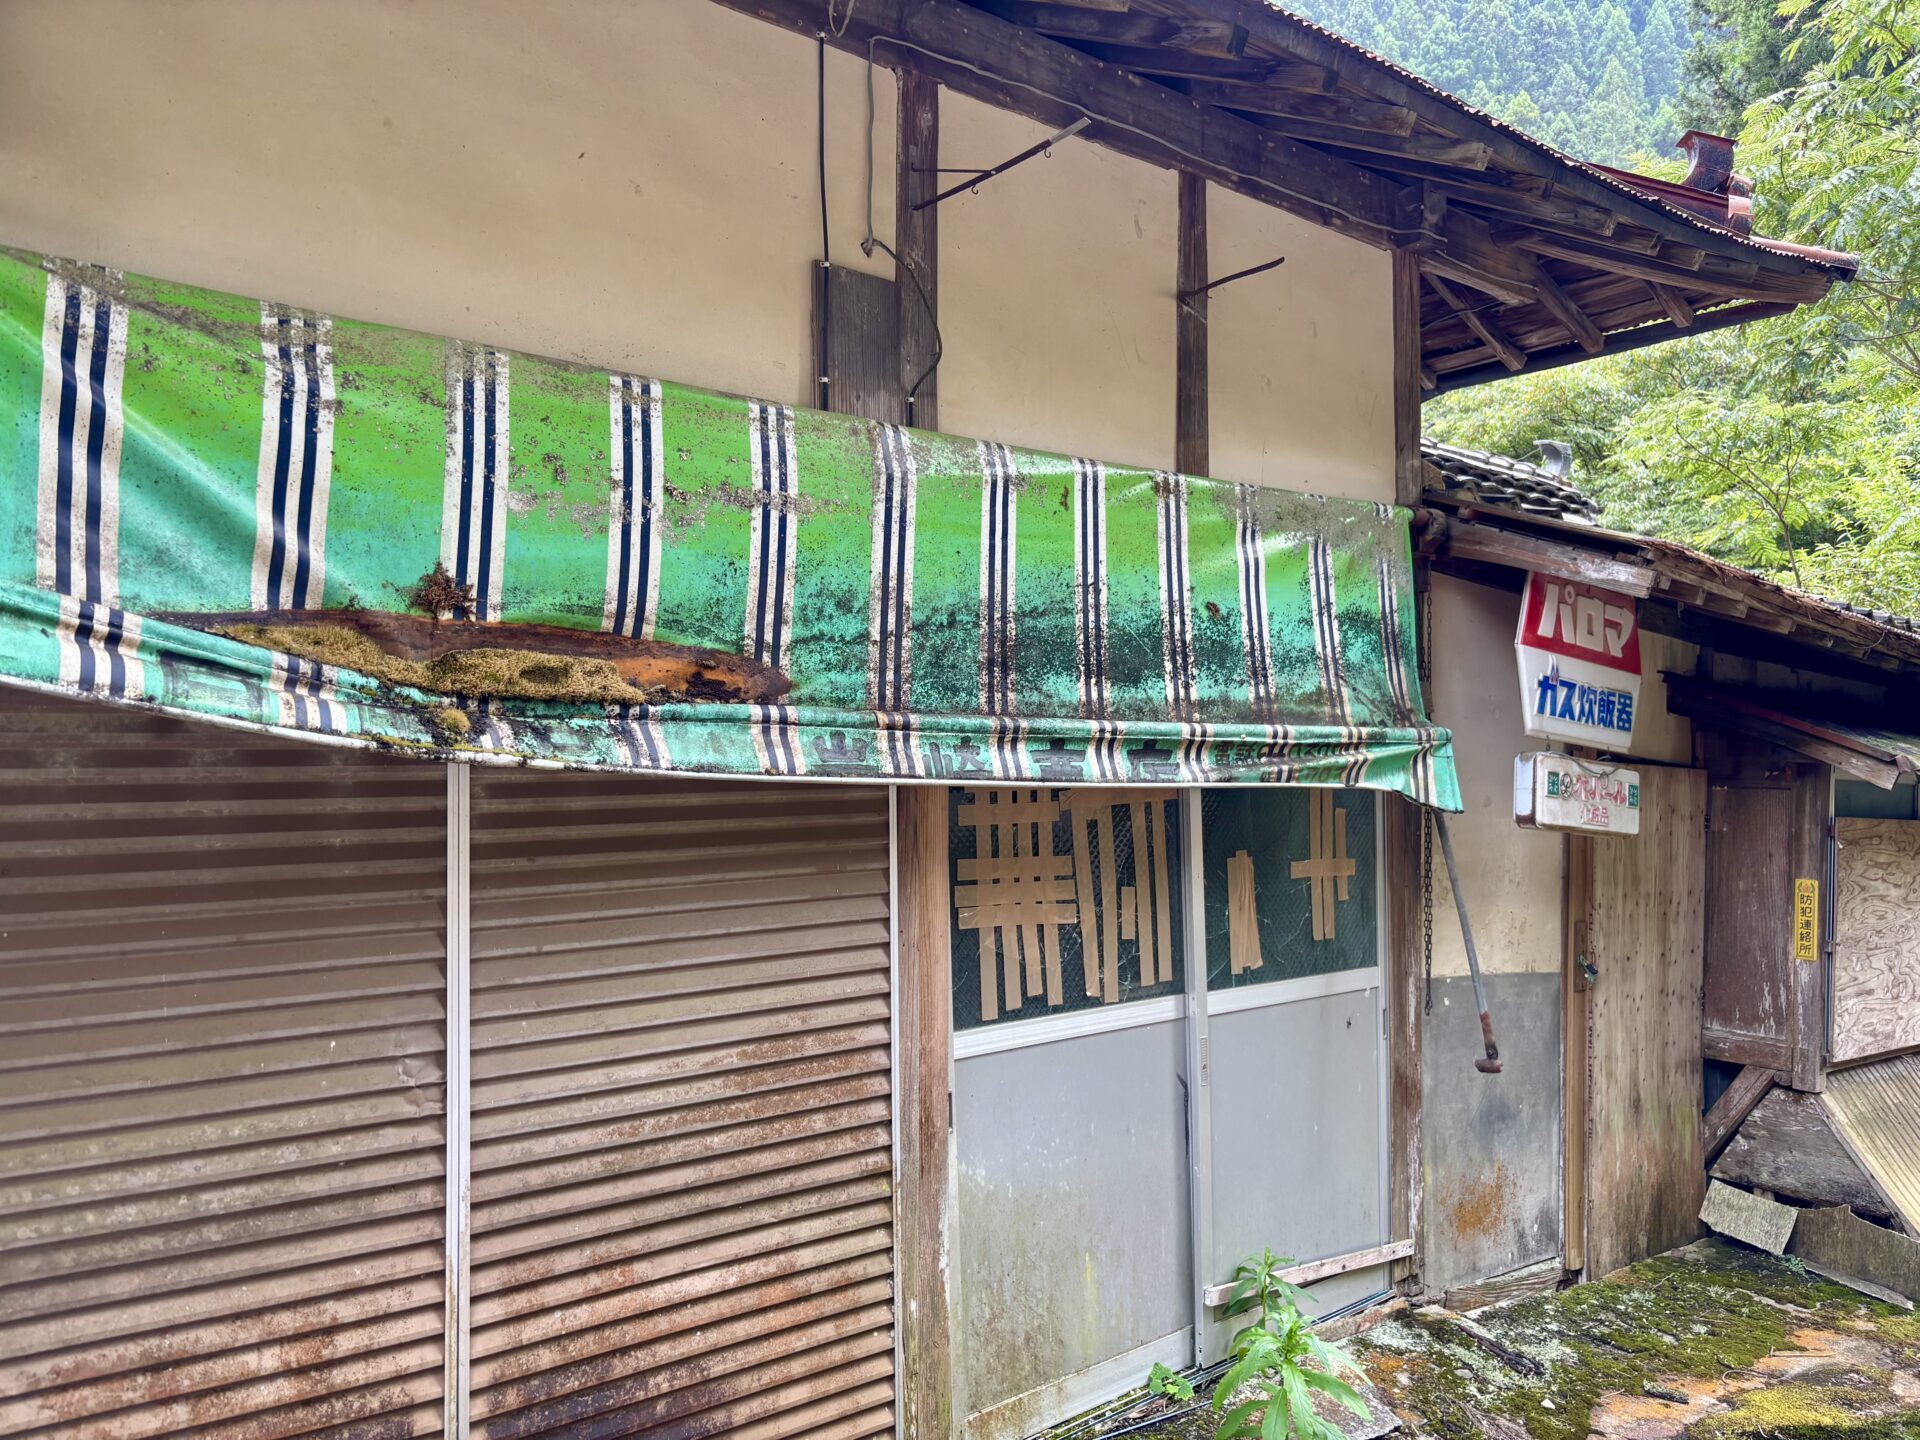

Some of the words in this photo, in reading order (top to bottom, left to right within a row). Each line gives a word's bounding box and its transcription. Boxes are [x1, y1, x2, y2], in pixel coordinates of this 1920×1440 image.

[1537, 583, 1635, 658] パロマ
[1536, 657, 1633, 733] ガス炊飯器
[1799, 893, 1813, 955] 防犯連絡所
